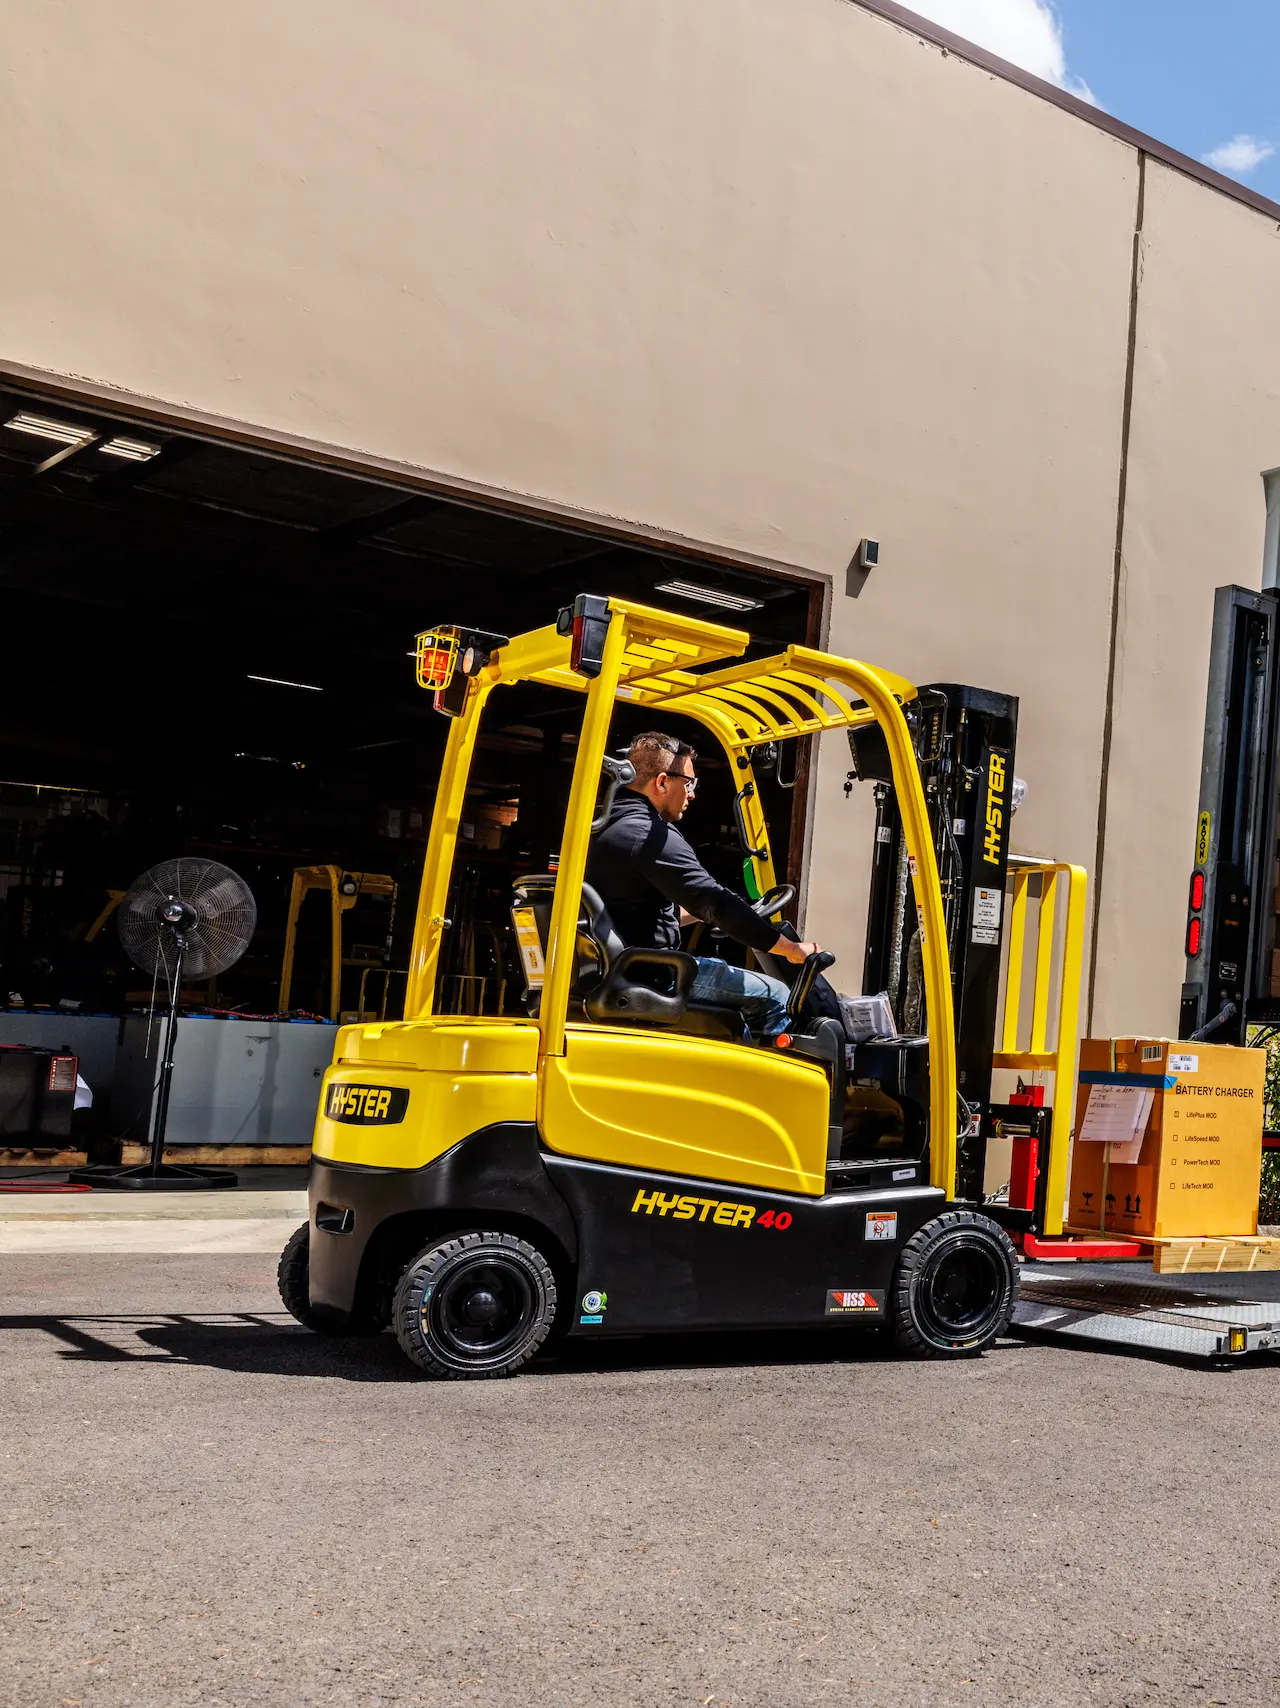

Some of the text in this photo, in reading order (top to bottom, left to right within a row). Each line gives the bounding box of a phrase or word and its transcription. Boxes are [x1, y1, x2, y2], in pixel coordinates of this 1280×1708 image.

[983, 751, 1006, 866] HYSTER
[1199, 818, 1208, 859] MAXON
[329, 1087, 392, 1119] HYSTER
[1175, 1085, 1254, 1098] BATTERY CHARGER
[1186, 1111, 1205, 1119] LifePlus
[631, 1189, 793, 1231] HYSTER 40
[842, 1292, 866, 1307] HSS
